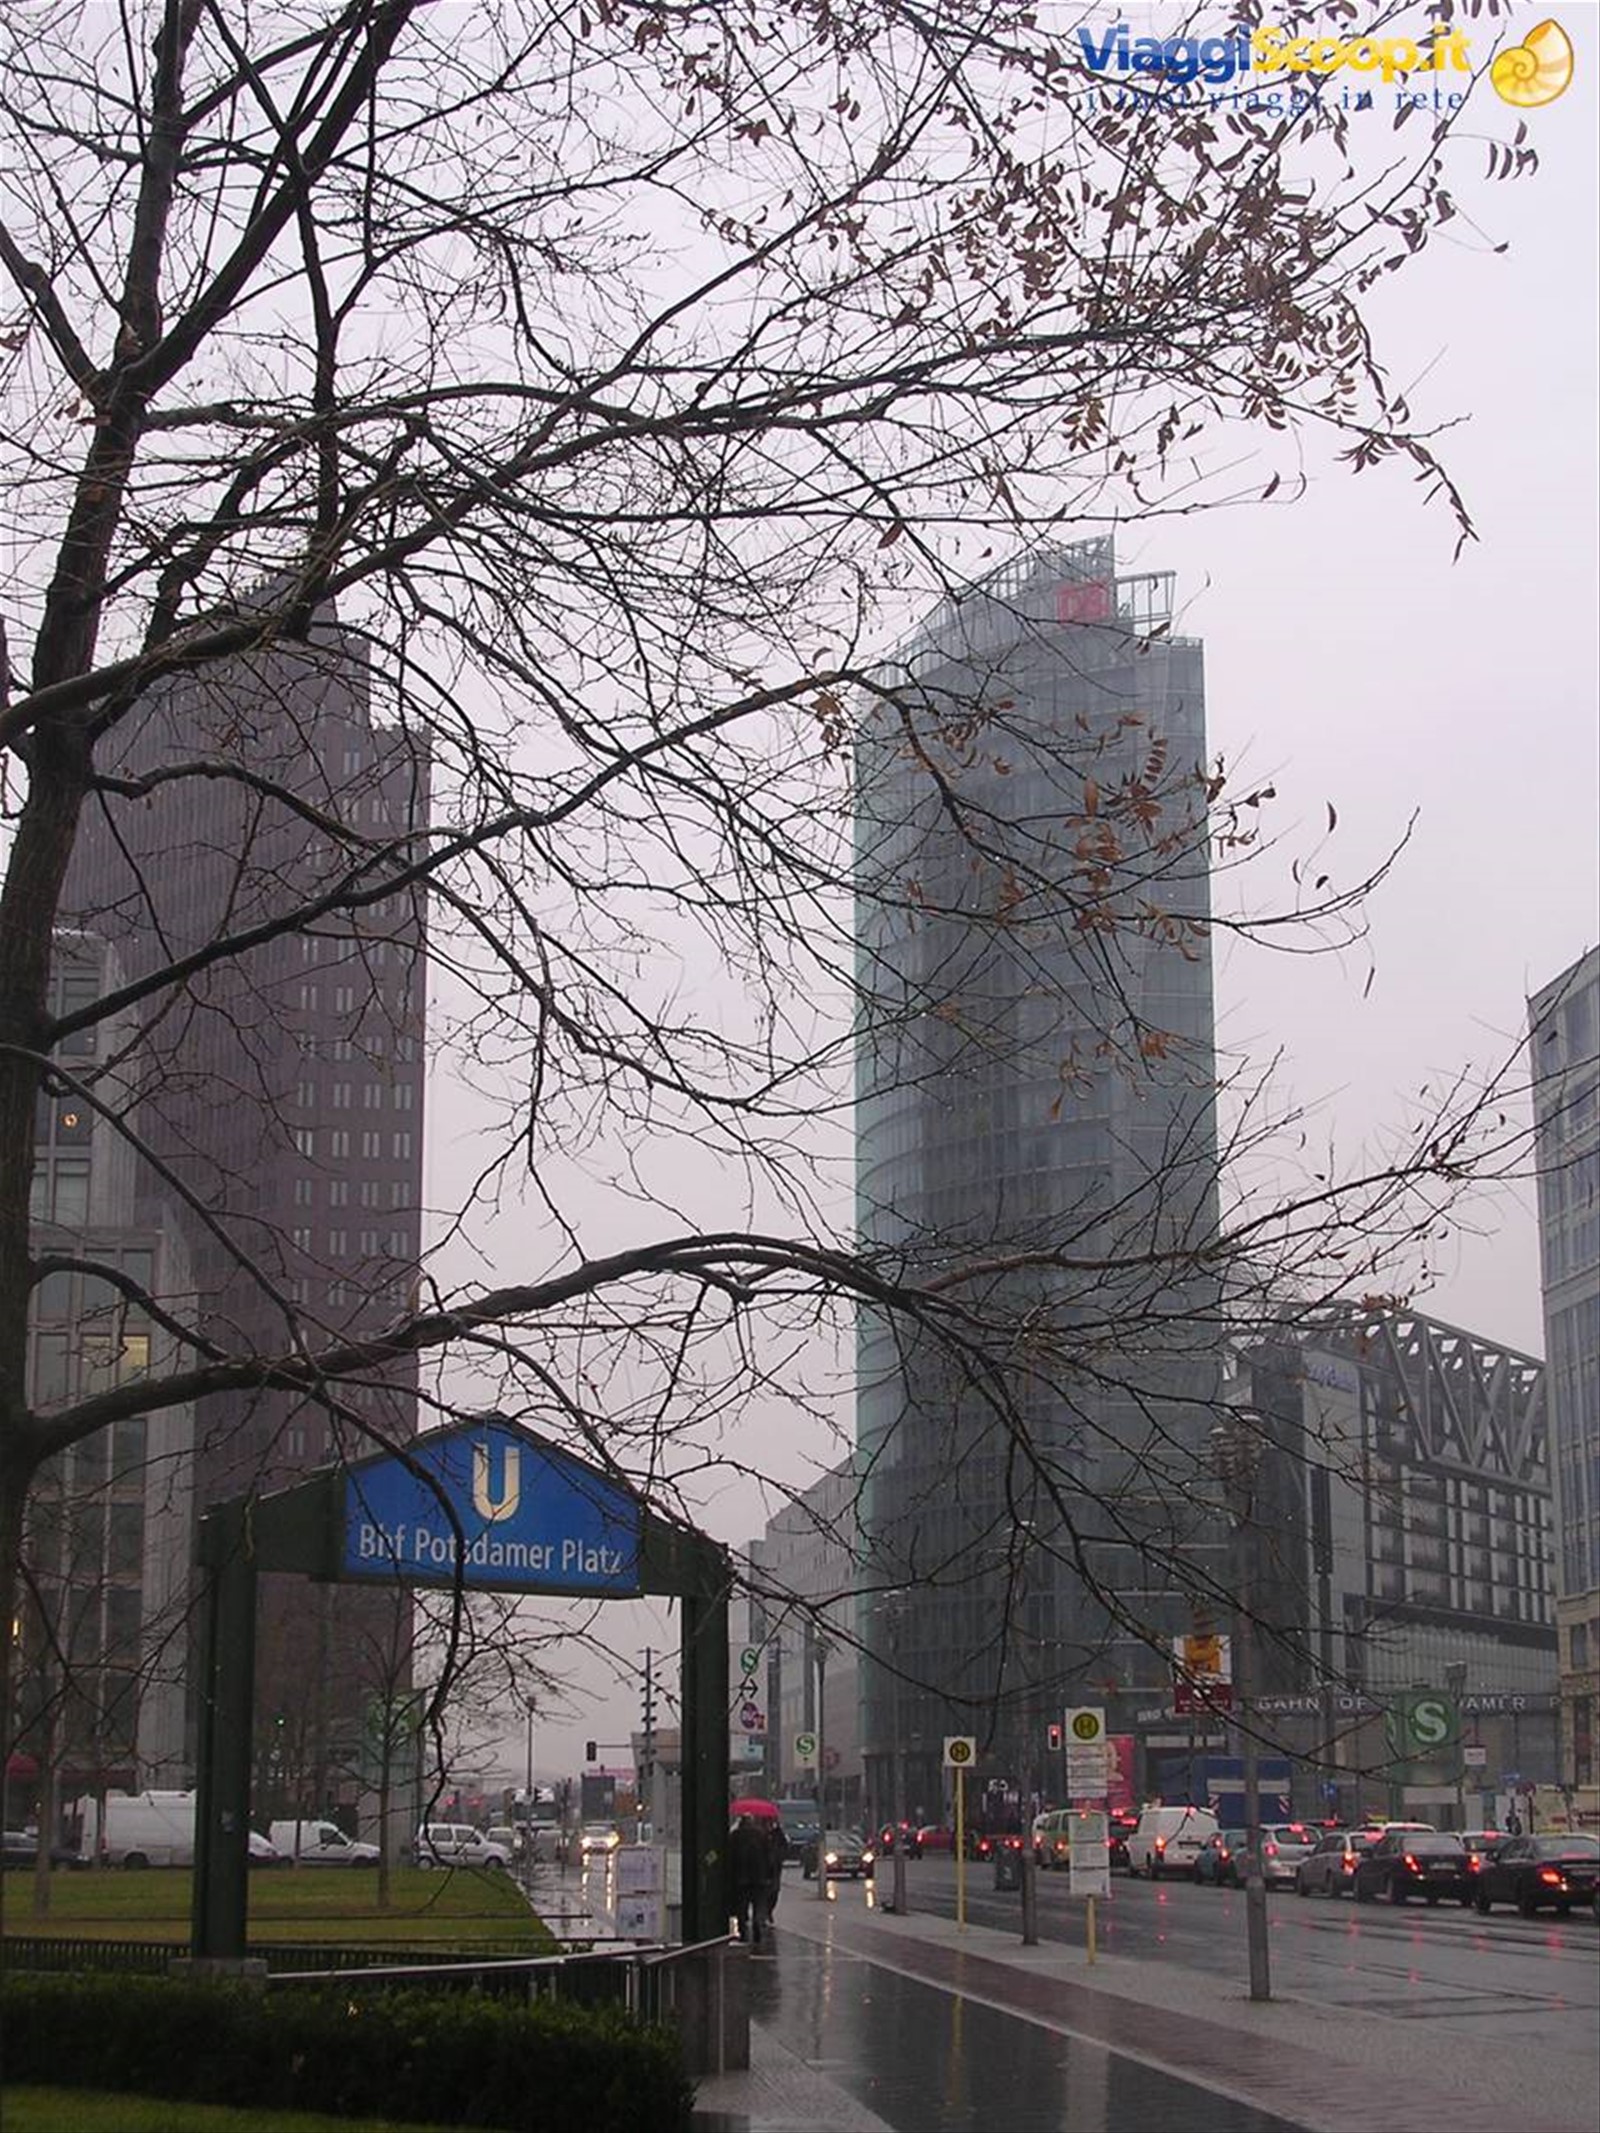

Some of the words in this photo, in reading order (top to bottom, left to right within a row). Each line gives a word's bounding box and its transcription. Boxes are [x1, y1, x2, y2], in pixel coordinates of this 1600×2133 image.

[473, 1444, 520, 1521] U
[360, 1523, 406, 1560] Bhf
[561, 1538, 622, 1575] Platz
[1415, 1702, 1447, 1742] S
